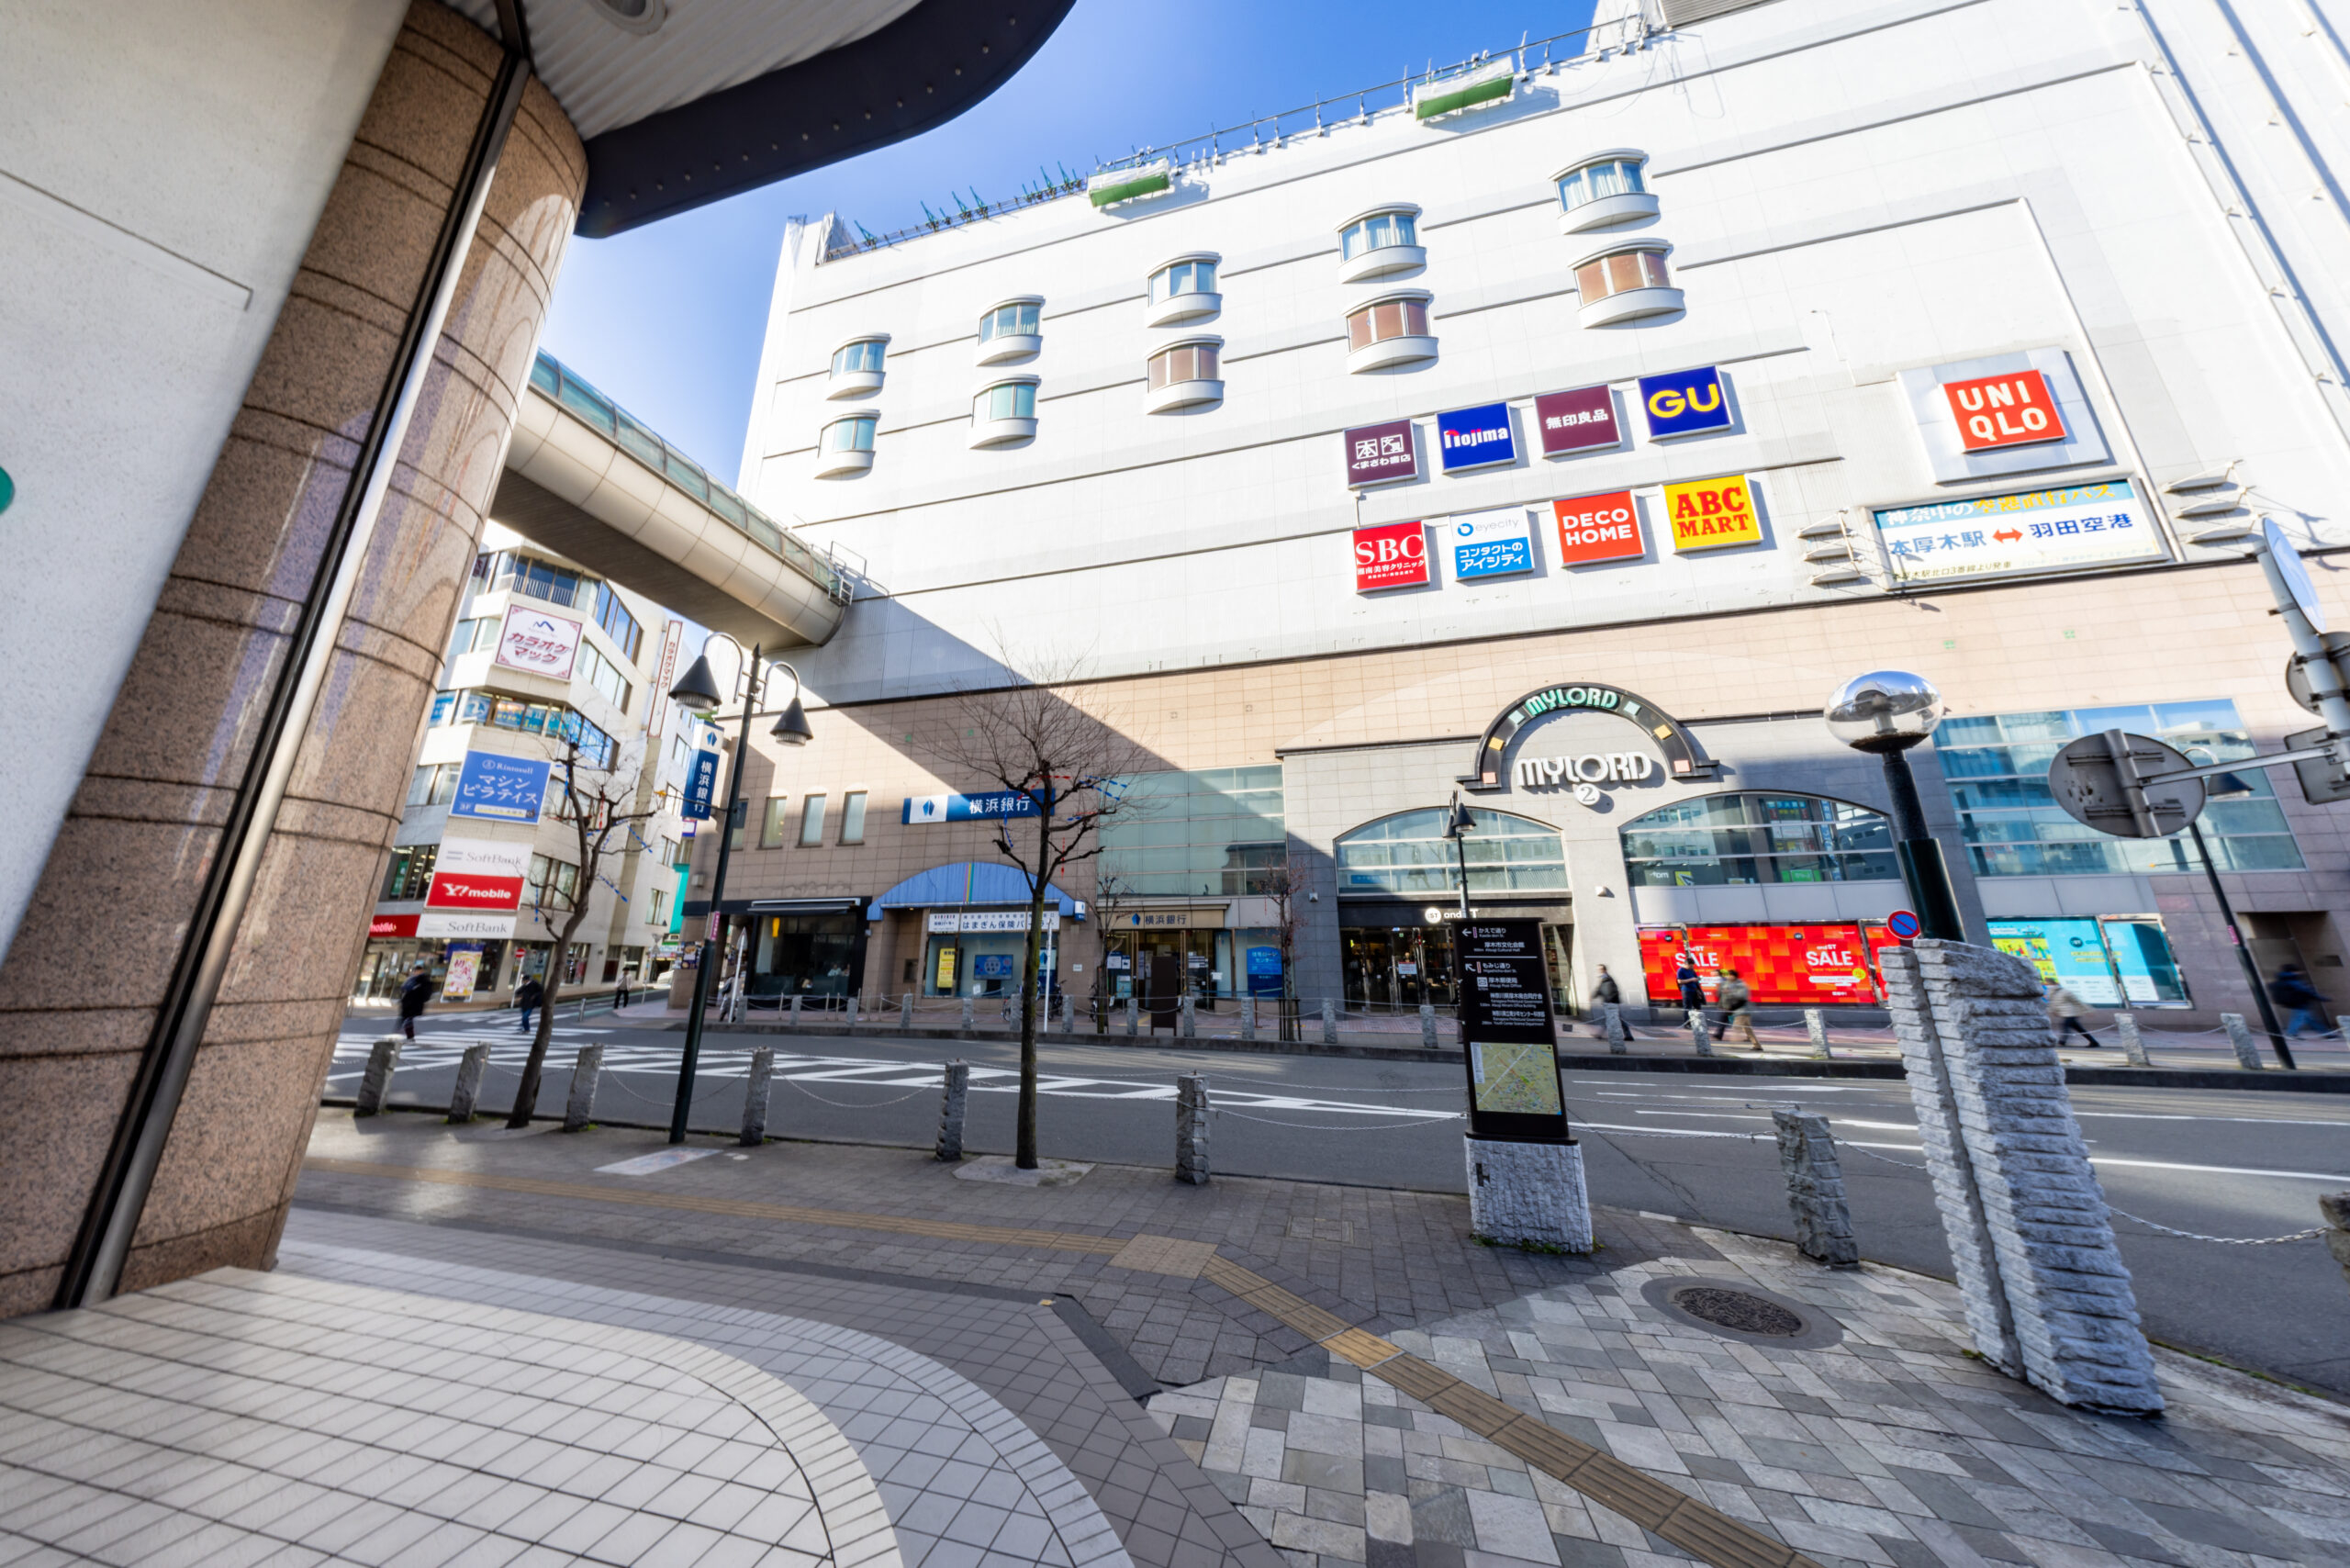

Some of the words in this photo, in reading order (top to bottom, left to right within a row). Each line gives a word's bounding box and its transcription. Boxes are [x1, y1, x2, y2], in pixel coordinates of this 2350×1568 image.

[1649, 383, 1720, 419] GU
[1956, 380, 2032, 411] UNI
[1545, 408, 1609, 430] 無印良品
[1968, 407, 2049, 442] QLO
[1443, 427, 1509, 449] nojima
[1351, 454, 1412, 470] くまざわ書店
[1674, 487, 1746, 520] ABC
[1475, 518, 1520, 533] eyecity
[1561, 508, 1630, 530] DECO
[1676, 513, 1750, 538] MART
[1565, 524, 1633, 546] HOME
[1888, 530, 1987, 556] 本厚木駅
[2028, 513, 2133, 538] 羽田空港
[1355, 534, 1424, 566] SBC
[1459, 542, 1524, 559] コンタクトの
[1460, 554, 1525, 572] アイシティ
[506, 633, 571, 654] カラオケ
[514, 645, 558, 664] マック
[1526, 687, 1618, 717] MYLORD
[1516, 751, 1652, 788] MYLORD
[478, 774, 532, 790] マシン
[695, 759, 713, 813] 横浜銀行
[463, 783, 538, 804] ピラティス
[1581, 786, 1596, 802] 2
[968, 795, 1031, 814] 横浜銀行
[465, 851, 522, 866] SoftBank
[447, 921, 508, 934] SoftBank
[1145, 914, 1187, 925] 横浜銀行
[1806, 950, 1853, 967] SALE
